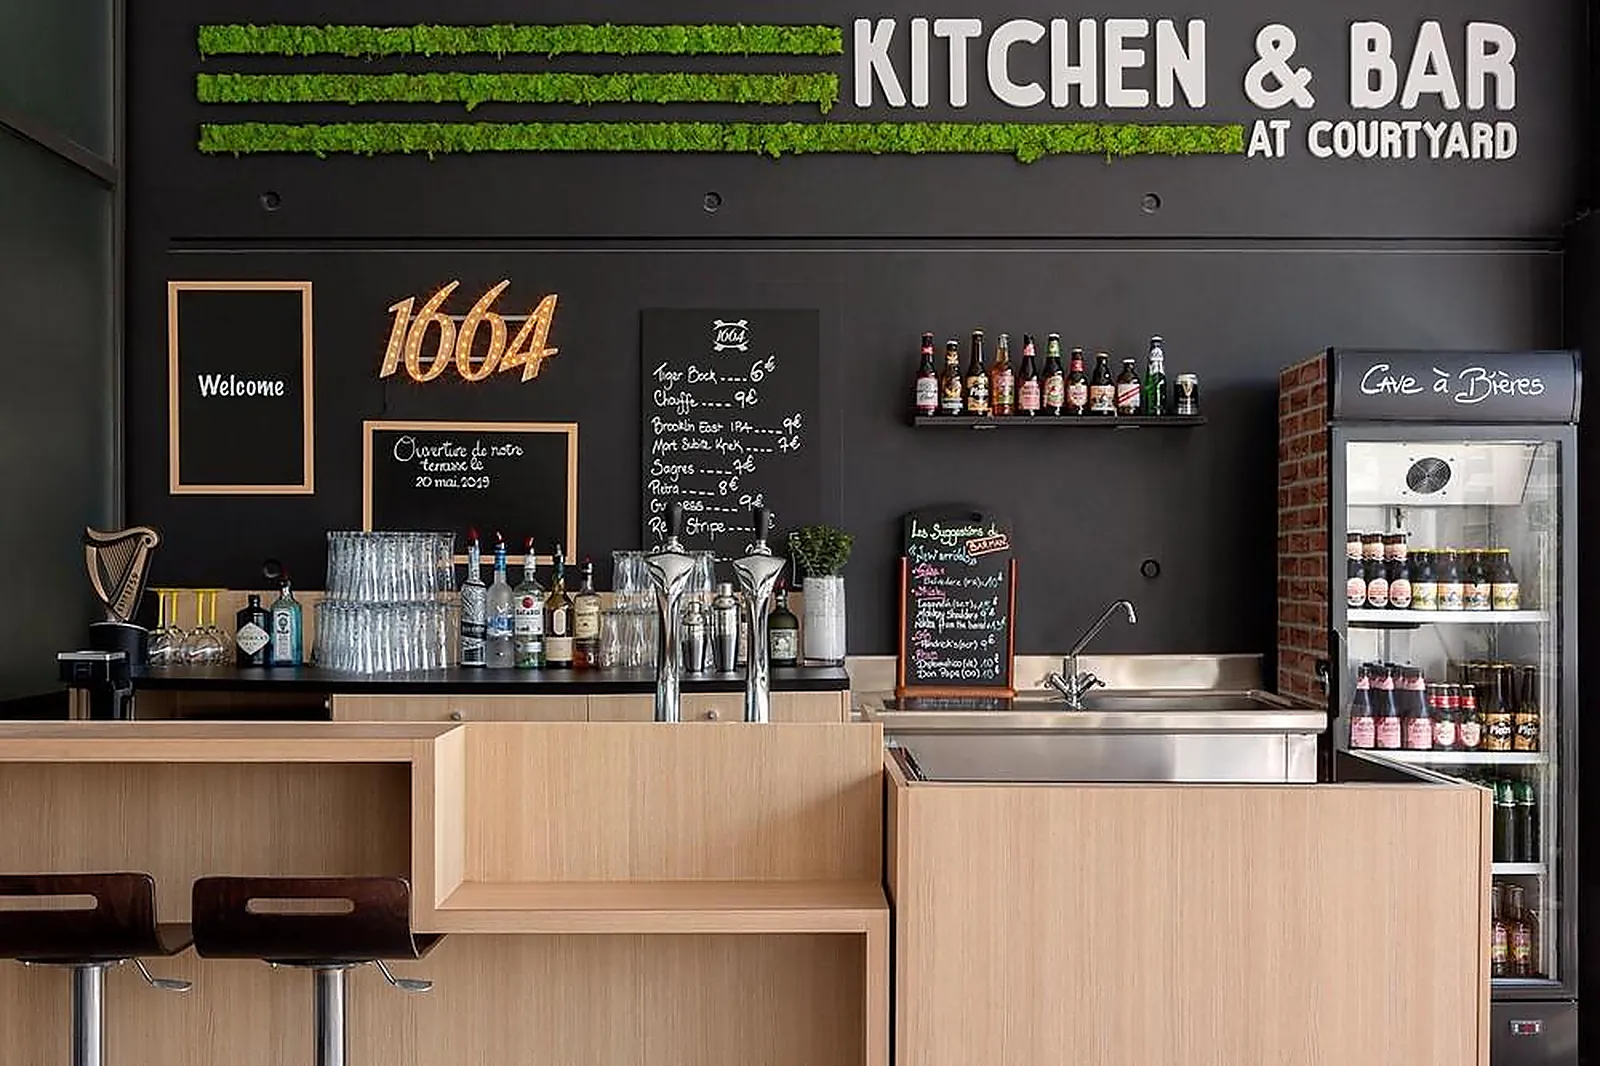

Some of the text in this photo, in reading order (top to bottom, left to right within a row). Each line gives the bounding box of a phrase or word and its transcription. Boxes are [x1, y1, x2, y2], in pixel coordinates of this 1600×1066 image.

[853, 18, 1516, 110] KITCHEN & BAR
[1246, 119, 1518, 161] AT COURTYARD
[379, 279, 559, 383] 1664
[198, 374, 284, 398] Welcome
[653, 362, 683, 390] Tiger
[1433, 367, 1450, 393] à
[1454, 367, 1545, 403] Bières
[699, 421, 724, 434] East
[730, 420, 753, 434] IPA
[471, 440, 488, 457] de
[415, 476, 433, 488] 20
[650, 458, 695, 482] Sagres
[648, 516, 668, 541] Re
[686, 517, 726, 541] Stripe
